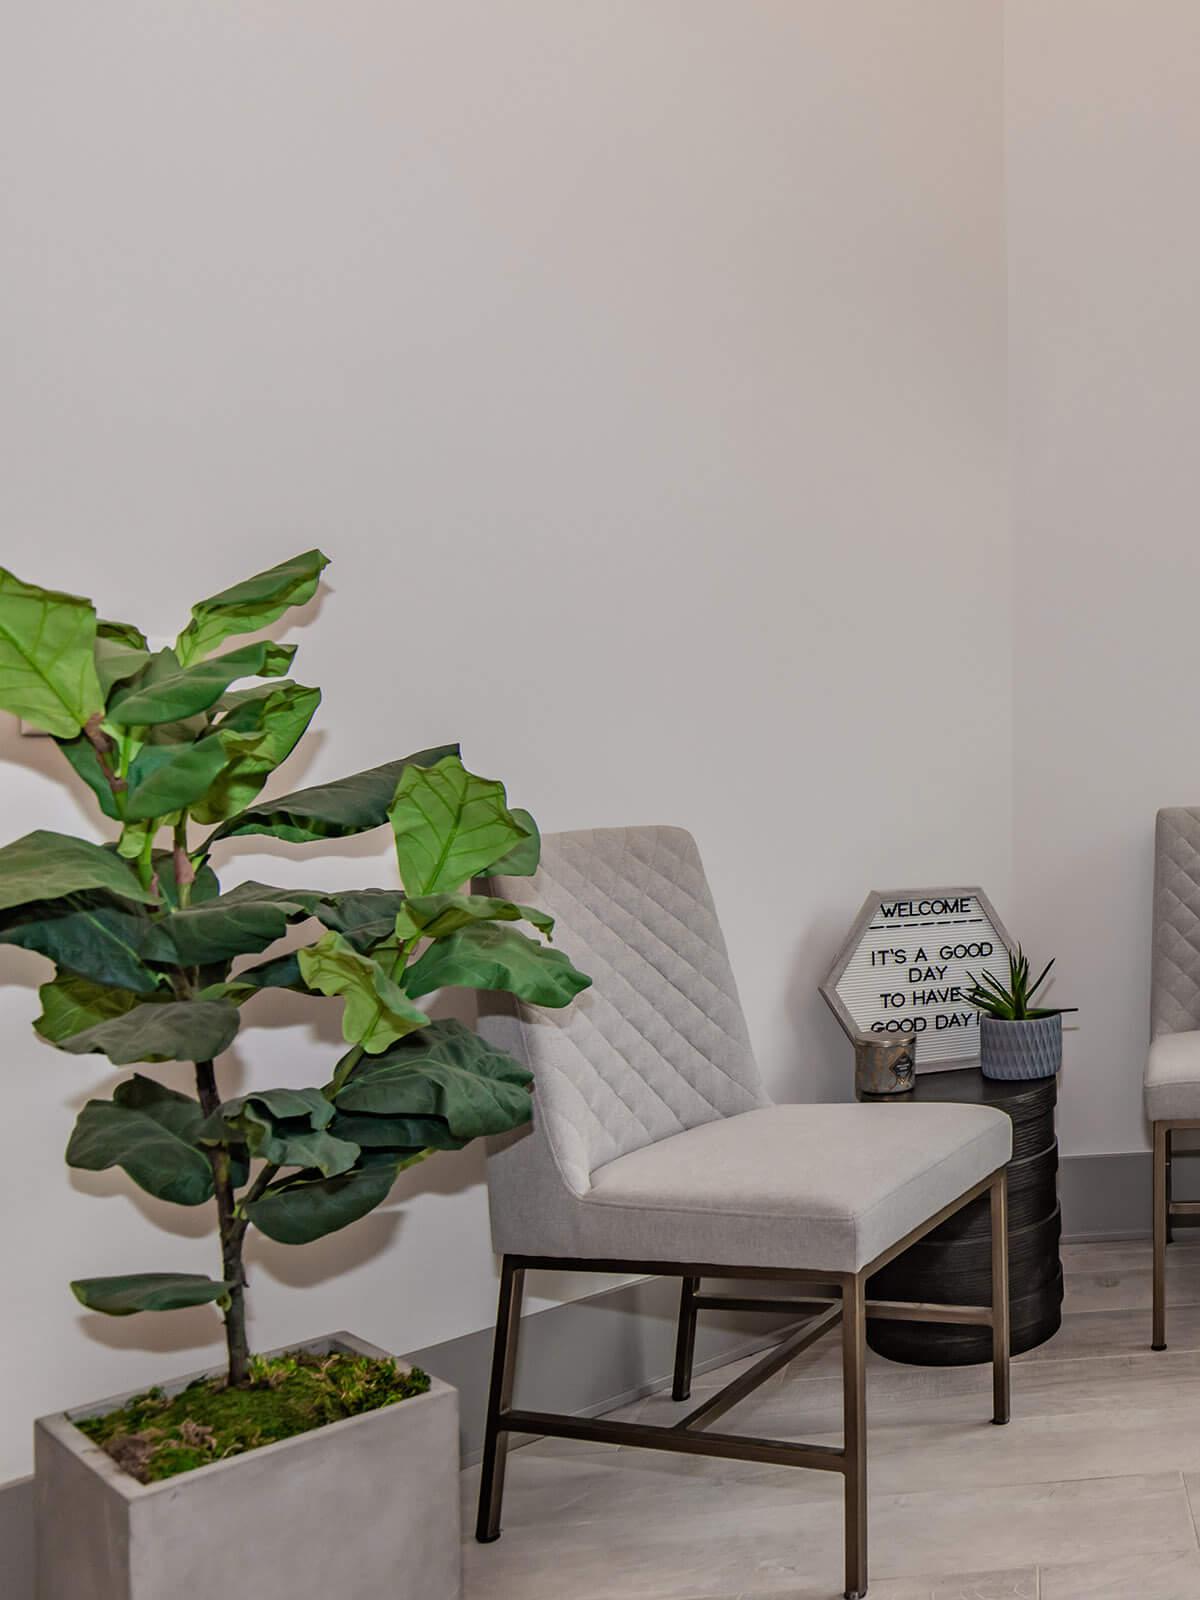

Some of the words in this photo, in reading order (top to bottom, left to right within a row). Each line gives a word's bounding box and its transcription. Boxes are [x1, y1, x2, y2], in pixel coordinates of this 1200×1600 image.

[880, 898, 971, 918] WELCOME
[871, 948, 907, 966] IT'S
[914, 947, 928, 963] A
[939, 942, 993, 960] GOOD
[908, 966, 948, 983] DAY
[880, 993, 905, 1009] TO
[912, 986, 961, 1006] HAVE
[871, 1017, 927, 1033] GOOD
[935, 1010, 980, 1030] DAY!
